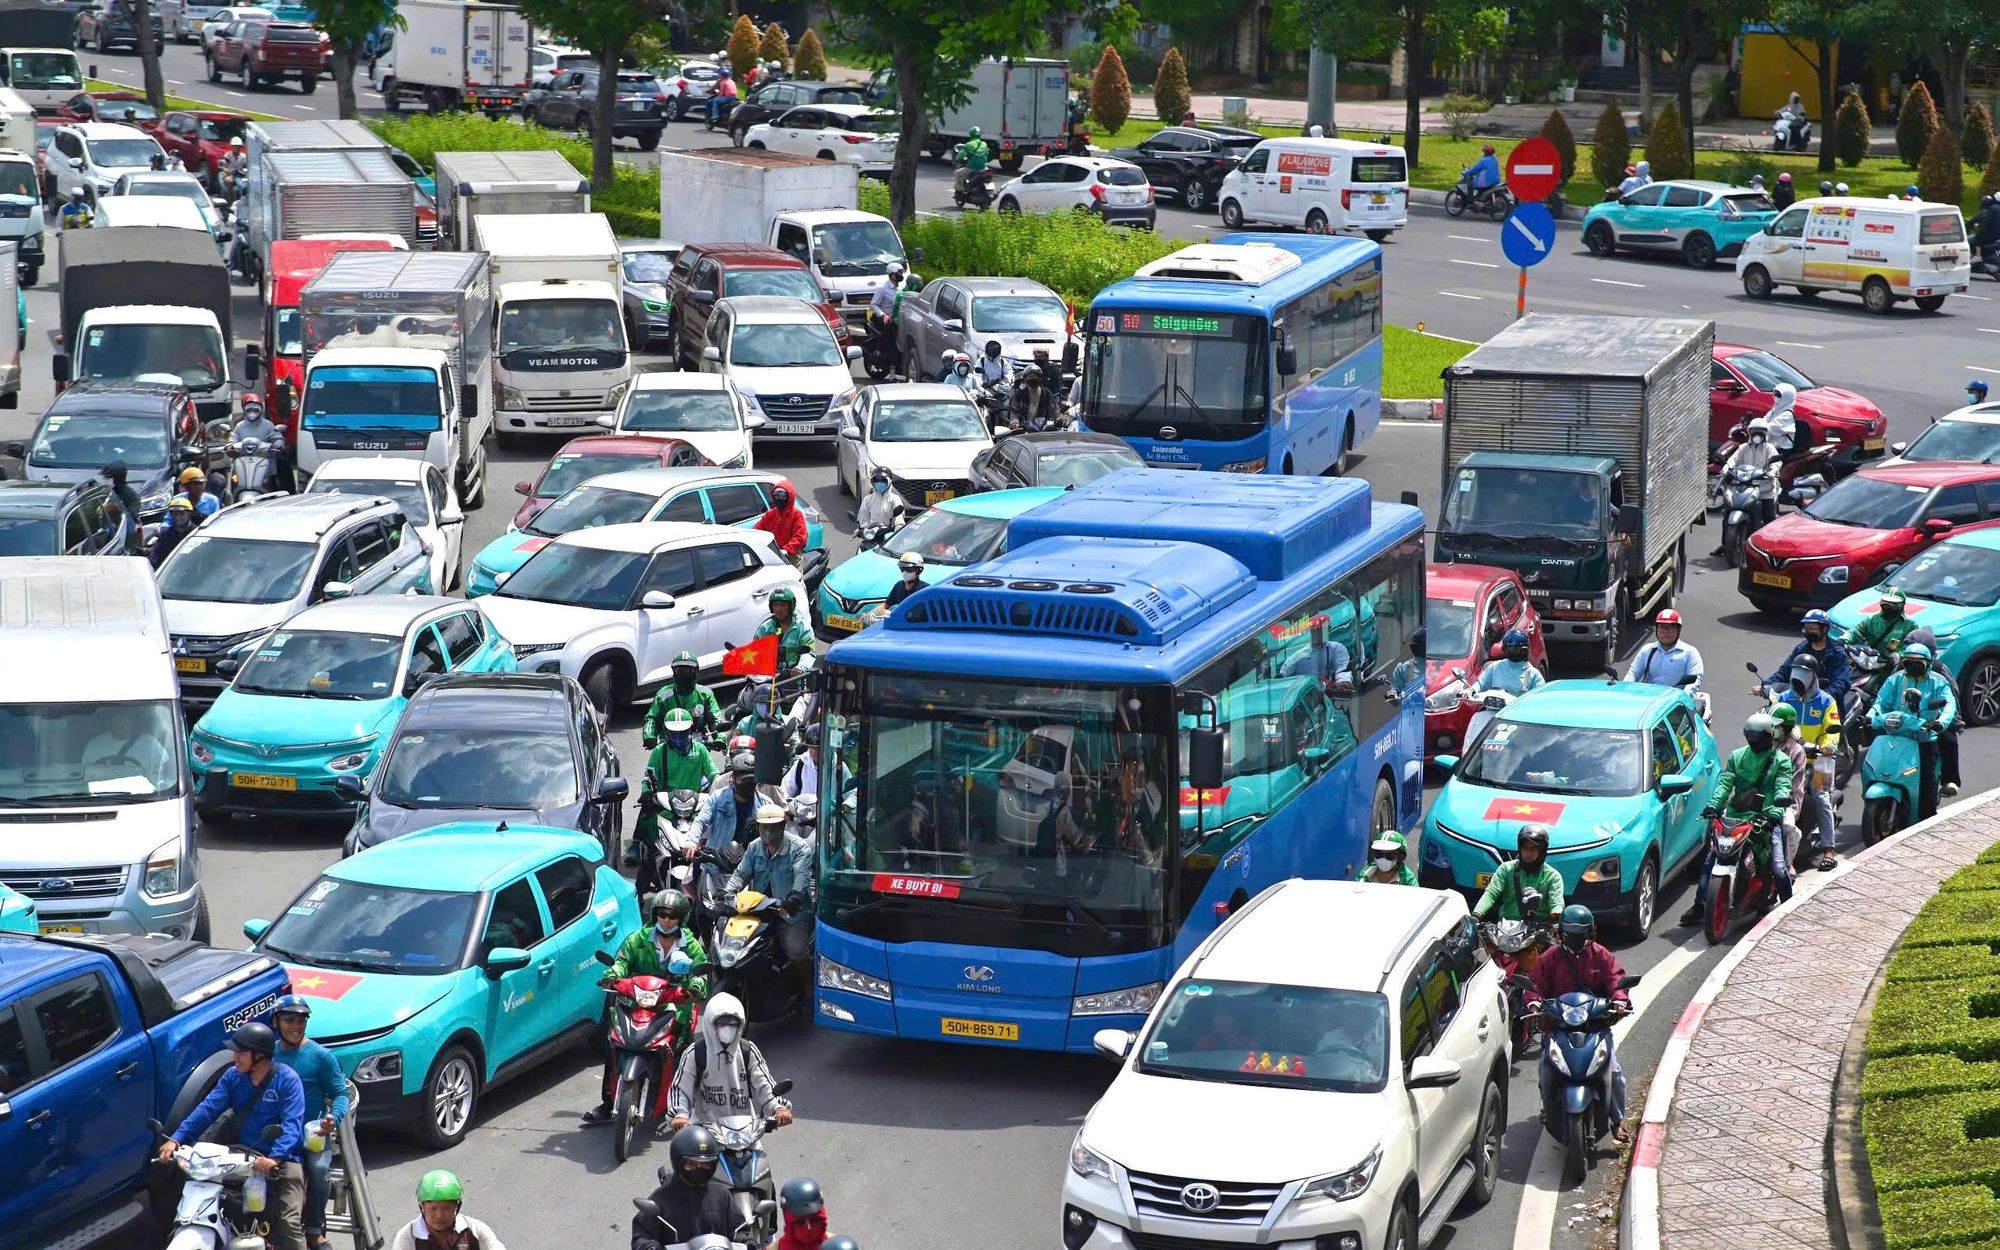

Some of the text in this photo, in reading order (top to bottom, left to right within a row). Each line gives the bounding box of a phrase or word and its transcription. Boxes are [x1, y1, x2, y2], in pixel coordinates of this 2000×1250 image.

[1287, 154, 1329, 168] LALAMOVE
[1097, 317, 1114, 331] 50
[1153, 315, 1219, 331] SaigonBus
[560, 358, 598, 366] MOTOR
[353, 442, 389, 450] ISUZU
[1152, 445, 1184, 454] SaigonBus
[1809, 706, 1822, 718] be
[890, 878, 943, 894] XE BUÝT ĐI
[301, 900, 325, 910] TAXI
[976, 984, 1001, 993] LONG
[223, 993, 277, 1033] RAPTOR
[948, 1021, 1011, 1037] 50H-869.71
